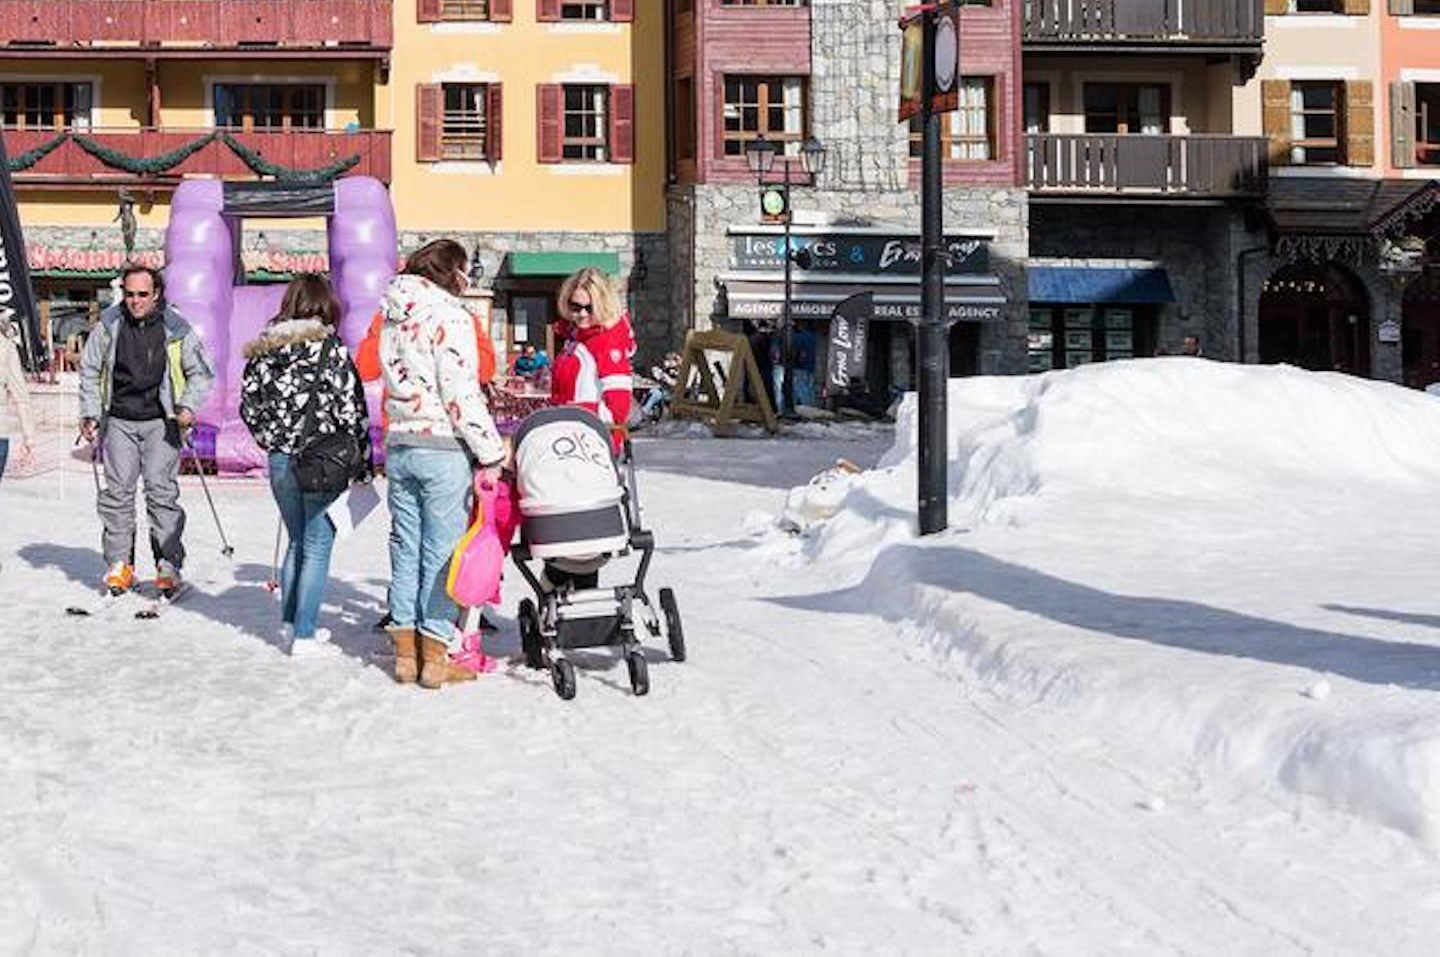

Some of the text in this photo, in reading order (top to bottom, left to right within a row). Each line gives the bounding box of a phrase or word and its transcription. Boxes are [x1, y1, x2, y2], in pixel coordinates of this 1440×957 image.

[849, 245, 865, 263] &
[879, 240, 921, 268] Ern
[873, 305, 905, 316] REAL
[948, 306, 1000, 318] AGENCY
